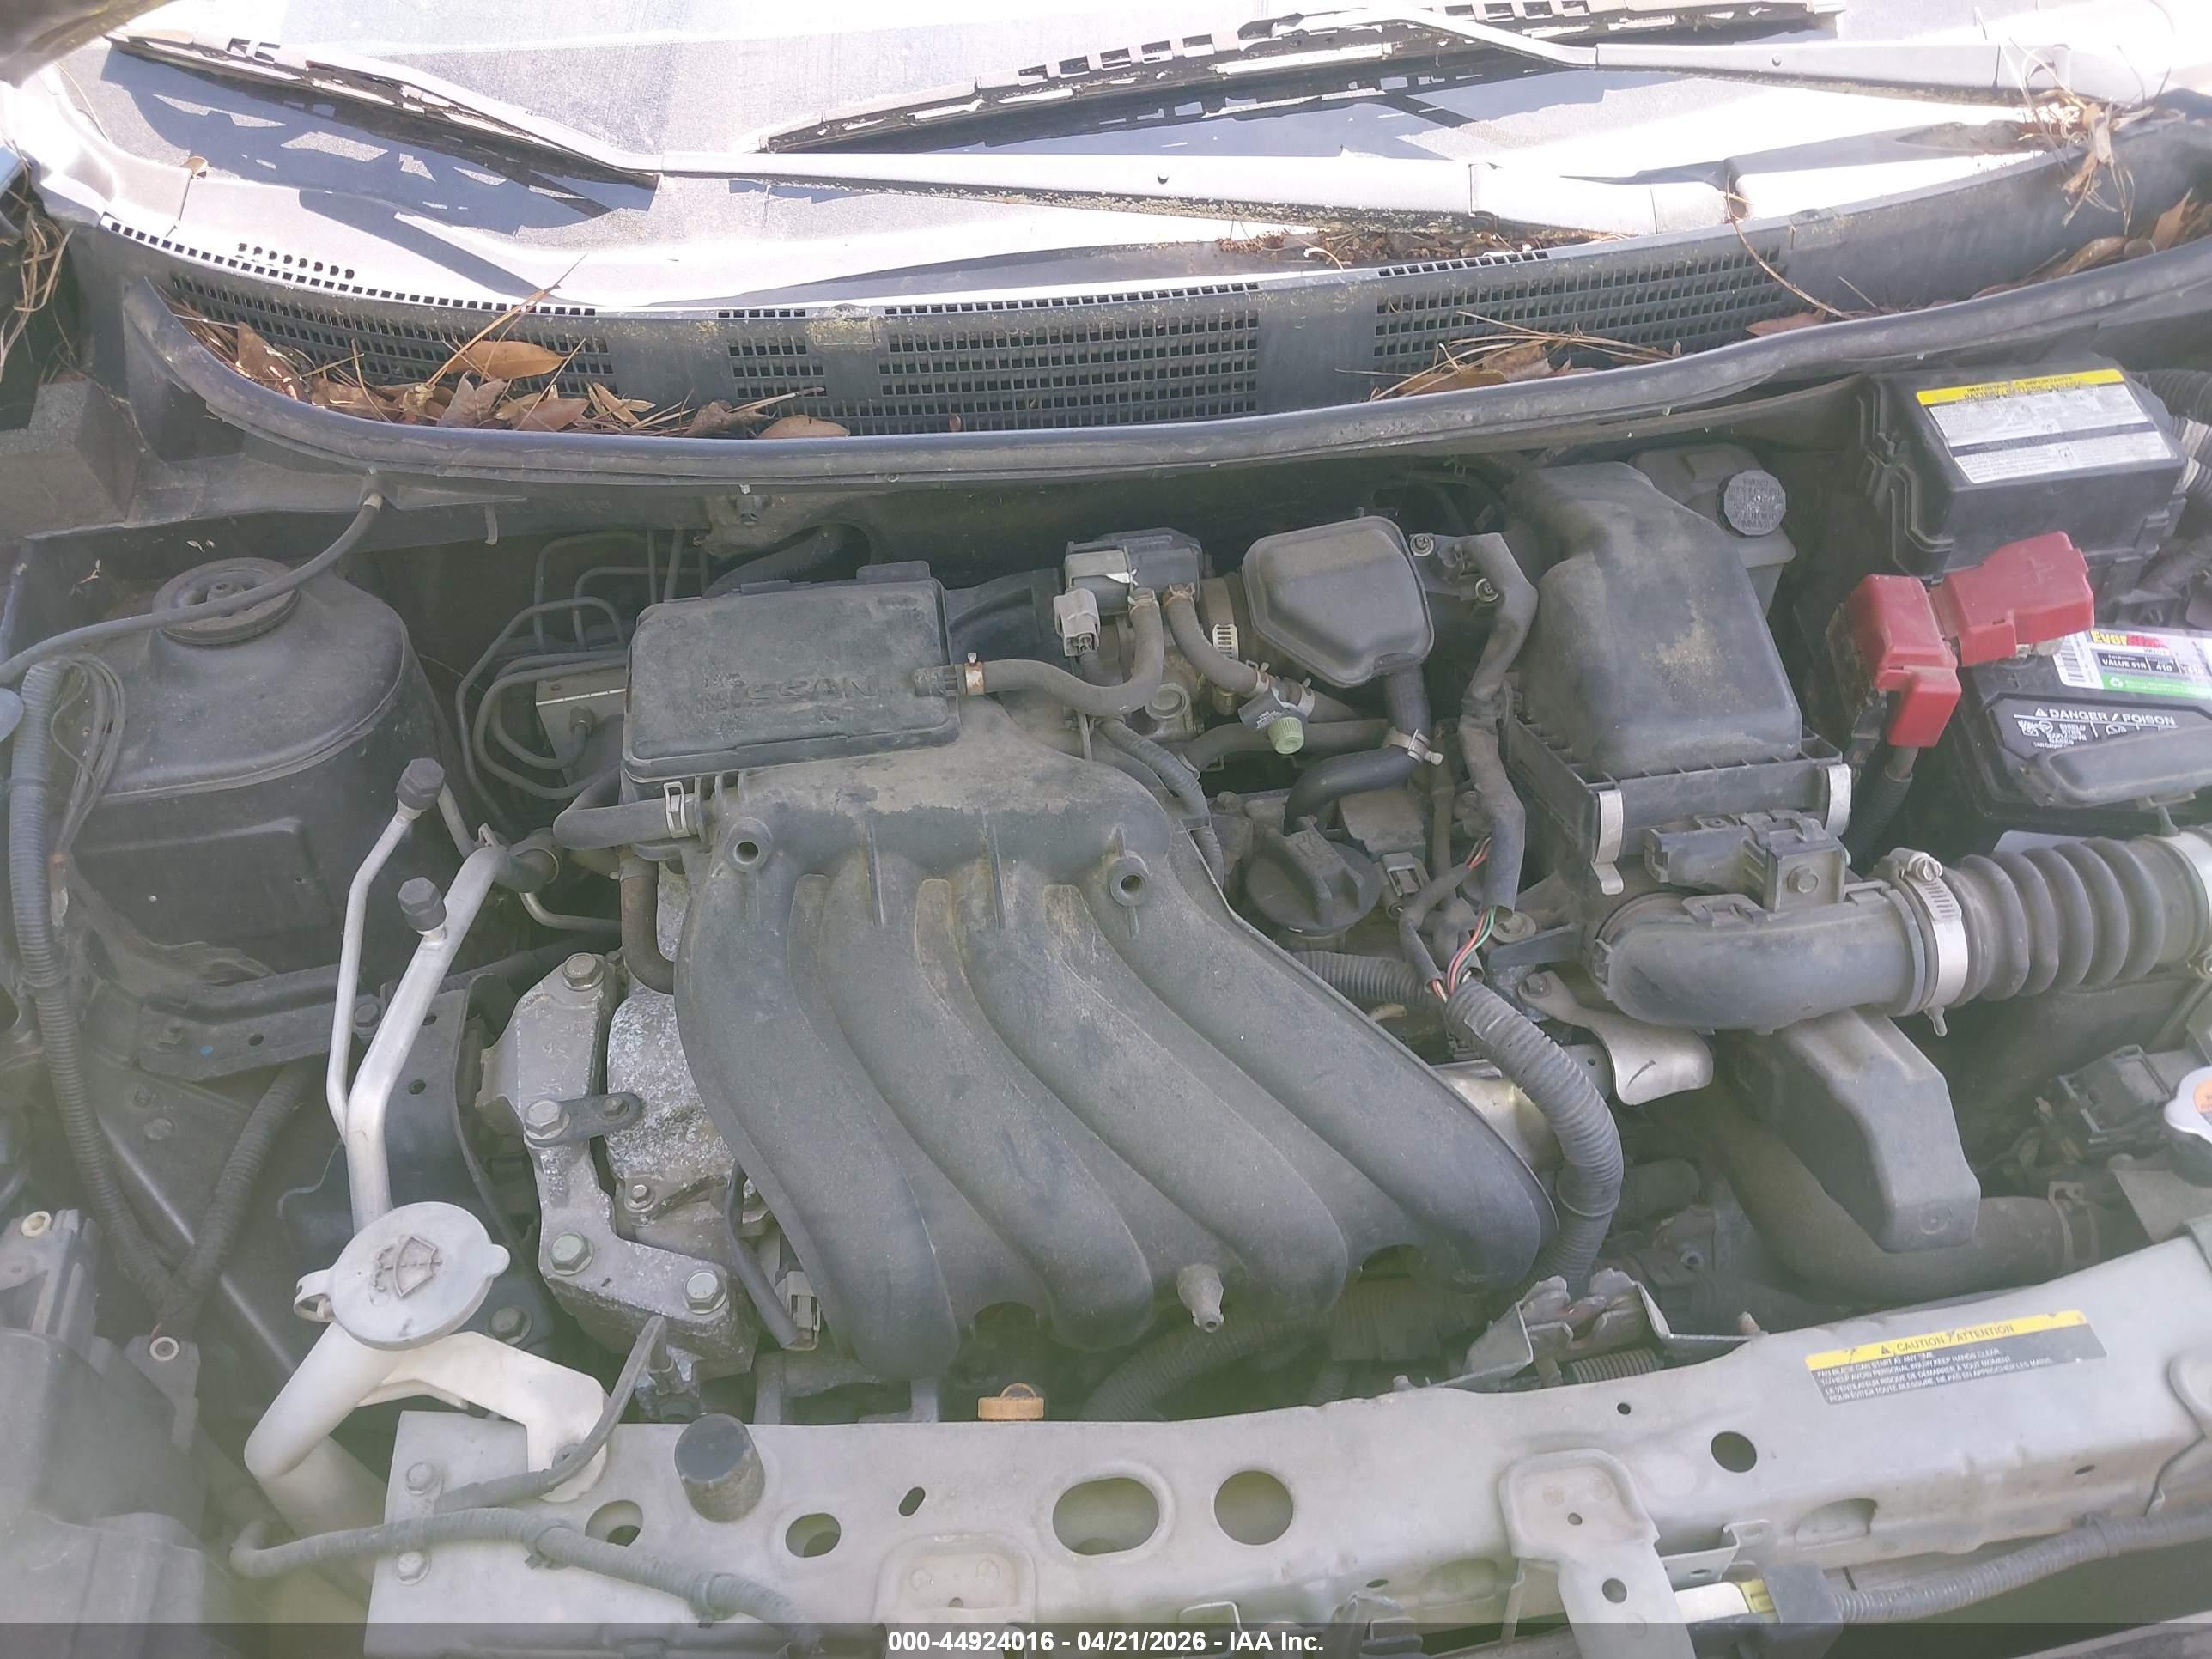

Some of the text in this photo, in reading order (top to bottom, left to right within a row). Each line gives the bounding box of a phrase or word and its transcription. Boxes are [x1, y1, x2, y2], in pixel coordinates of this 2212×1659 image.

[2102, 659, 2130, 668] VALUE
[2049, 708, 2175, 726] DANGER / POISON
[1896, 1336, 1945, 1352] CAUTION
[1956, 1325, 2014, 1342] ATTENTION
[1832, 1374, 1850, 1383] HELP
[1851, 1371, 1871, 1382] AVOID
[1872, 1365, 1909, 1376] PERSONAL
[1933, 1358, 1950, 1367] KEEP
[1952, 1354, 1975, 1364] HANDS
[1855, 1363, 1871, 1371] CAN
[1871, 1358, 1893, 1368] START
[1903, 1354, 1916, 1364] ANY
[1825, 1387, 1835, 1395] LE
[1836, 1379, 1879, 1393] VENTILATEUR
[1963, 1361, 1980, 1371] TOUT
[1829, 1393, 1850, 1402] POUR
[1874, 1384, 1897, 1395] TOUTE
